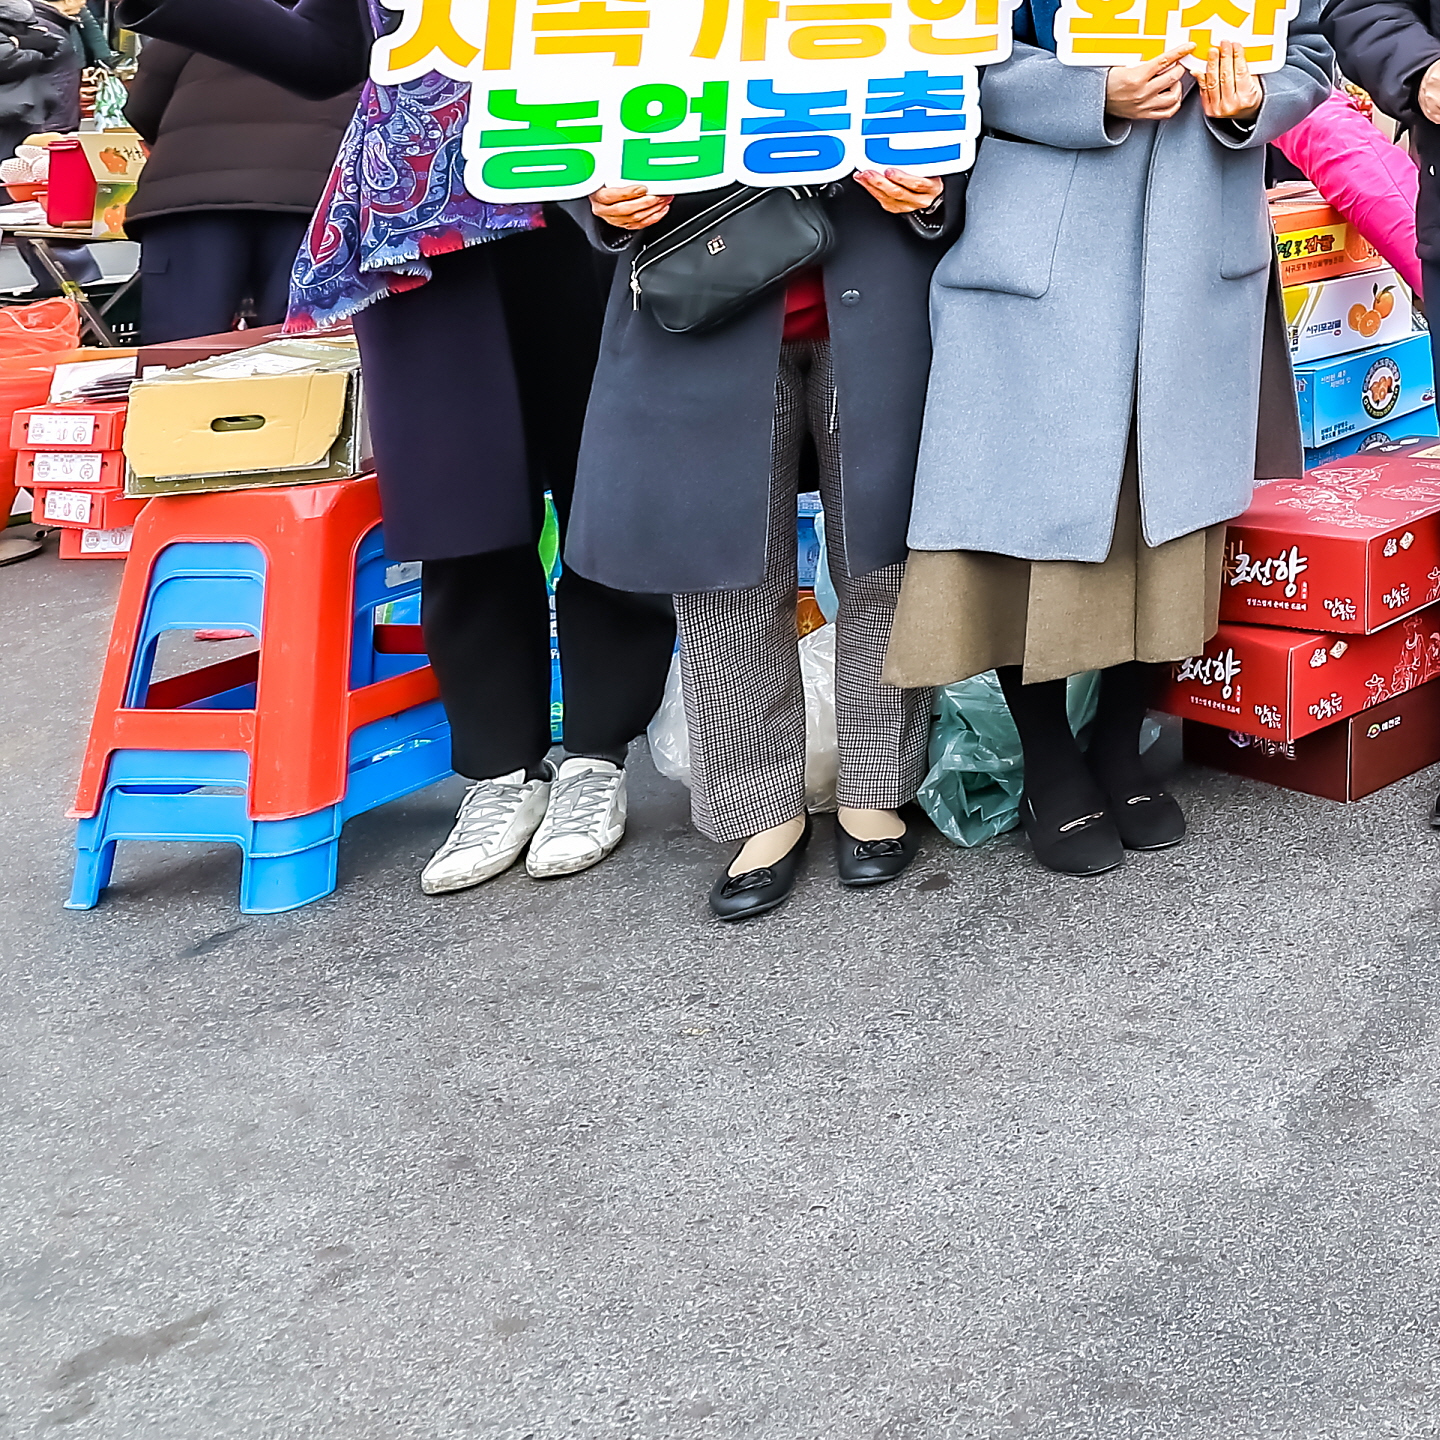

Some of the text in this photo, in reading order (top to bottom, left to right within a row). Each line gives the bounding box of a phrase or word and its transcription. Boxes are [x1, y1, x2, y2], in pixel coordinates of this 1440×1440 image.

[479, 70, 967, 190] 농업농촌
[1305, 318, 1342, 335] 서귀포감귤
[1230, 545, 1308, 598] 조선향
[1177, 647, 1242, 700] 조선향
